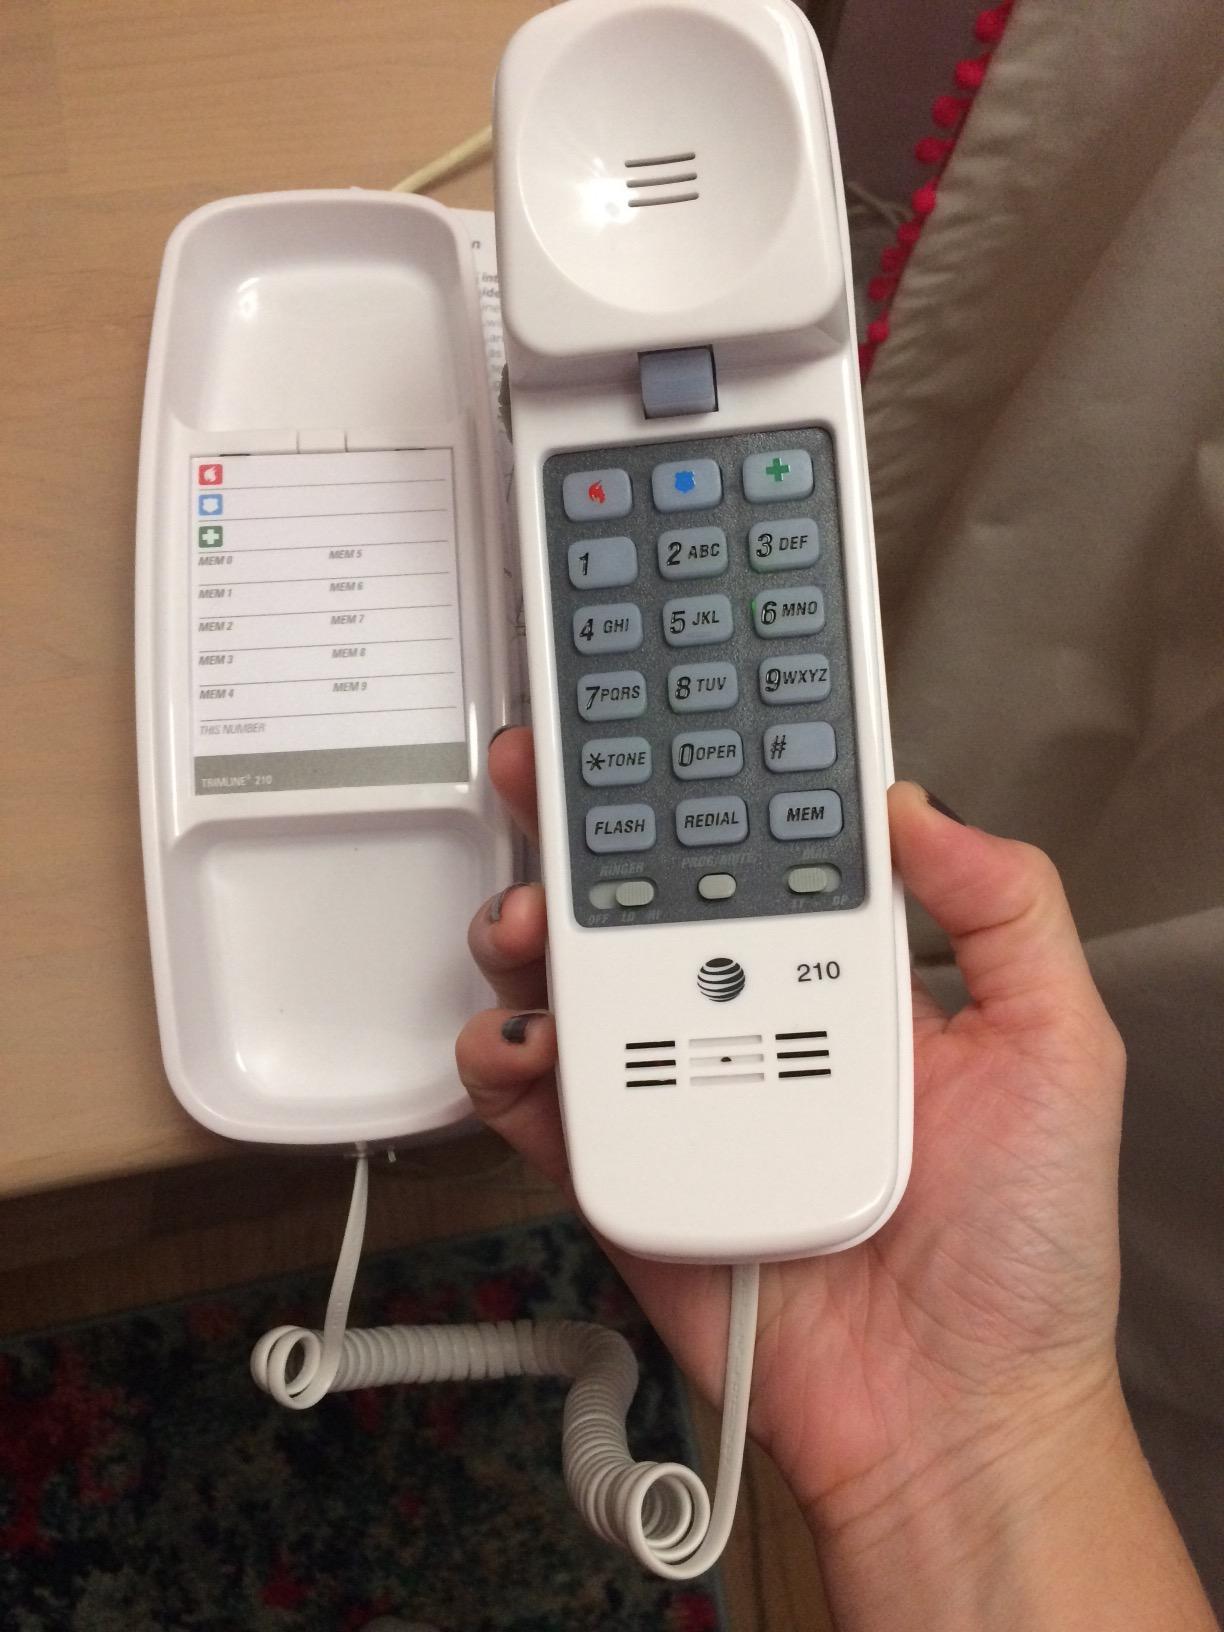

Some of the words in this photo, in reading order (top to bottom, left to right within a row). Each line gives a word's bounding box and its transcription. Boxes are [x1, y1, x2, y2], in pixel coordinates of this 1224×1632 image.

[756, 533, 773, 558] 3
[779, 535, 808, 551] DEF
[198, 556, 225, 566] MEM
[328, 549, 354, 559] MEM
[666, 541, 682, 567] 2
[688, 543, 720, 560] ABC
[579, 552, 589, 576] 1
[198, 588, 225, 599] MEM
[329, 582, 356, 592] MEM
[330, 615, 357, 625] MEM
[761, 601, 777, 625] 6
[782, 601, 818, 617] MNO
[198, 621, 225, 632] MEM
[580, 618, 595, 641] 4
[603, 618, 630, 633] GHI
[670, 610, 686, 634] 5
[692, 610, 720, 626] JKL
[198, 655, 226, 666] MEM
[332, 648, 358, 658] MEM
[333, 682, 359, 692] MEM
[675, 676, 691, 700] 8
[697, 676, 727, 692] TUV
[765, 668, 781, 692] 9
[783, 668, 828, 685] WXYZ
[199, 689, 226, 699] MEM
[585, 685, 601, 710] 7
[601, 685, 641, 702] PQRS
[200, 725, 221, 735] THIS
[222, 723, 266, 735] NUMBER
[696, 744, 737, 761] OPER
[770, 734, 787, 760] #
[607, 751, 647, 767] TONE
[254, 775, 273, 785] 210
[684, 811, 740, 829] REDIAL
[786, 806, 825, 822] MEM
[594, 819, 646, 835] FLASH
[797, 961, 841, 982] 210
